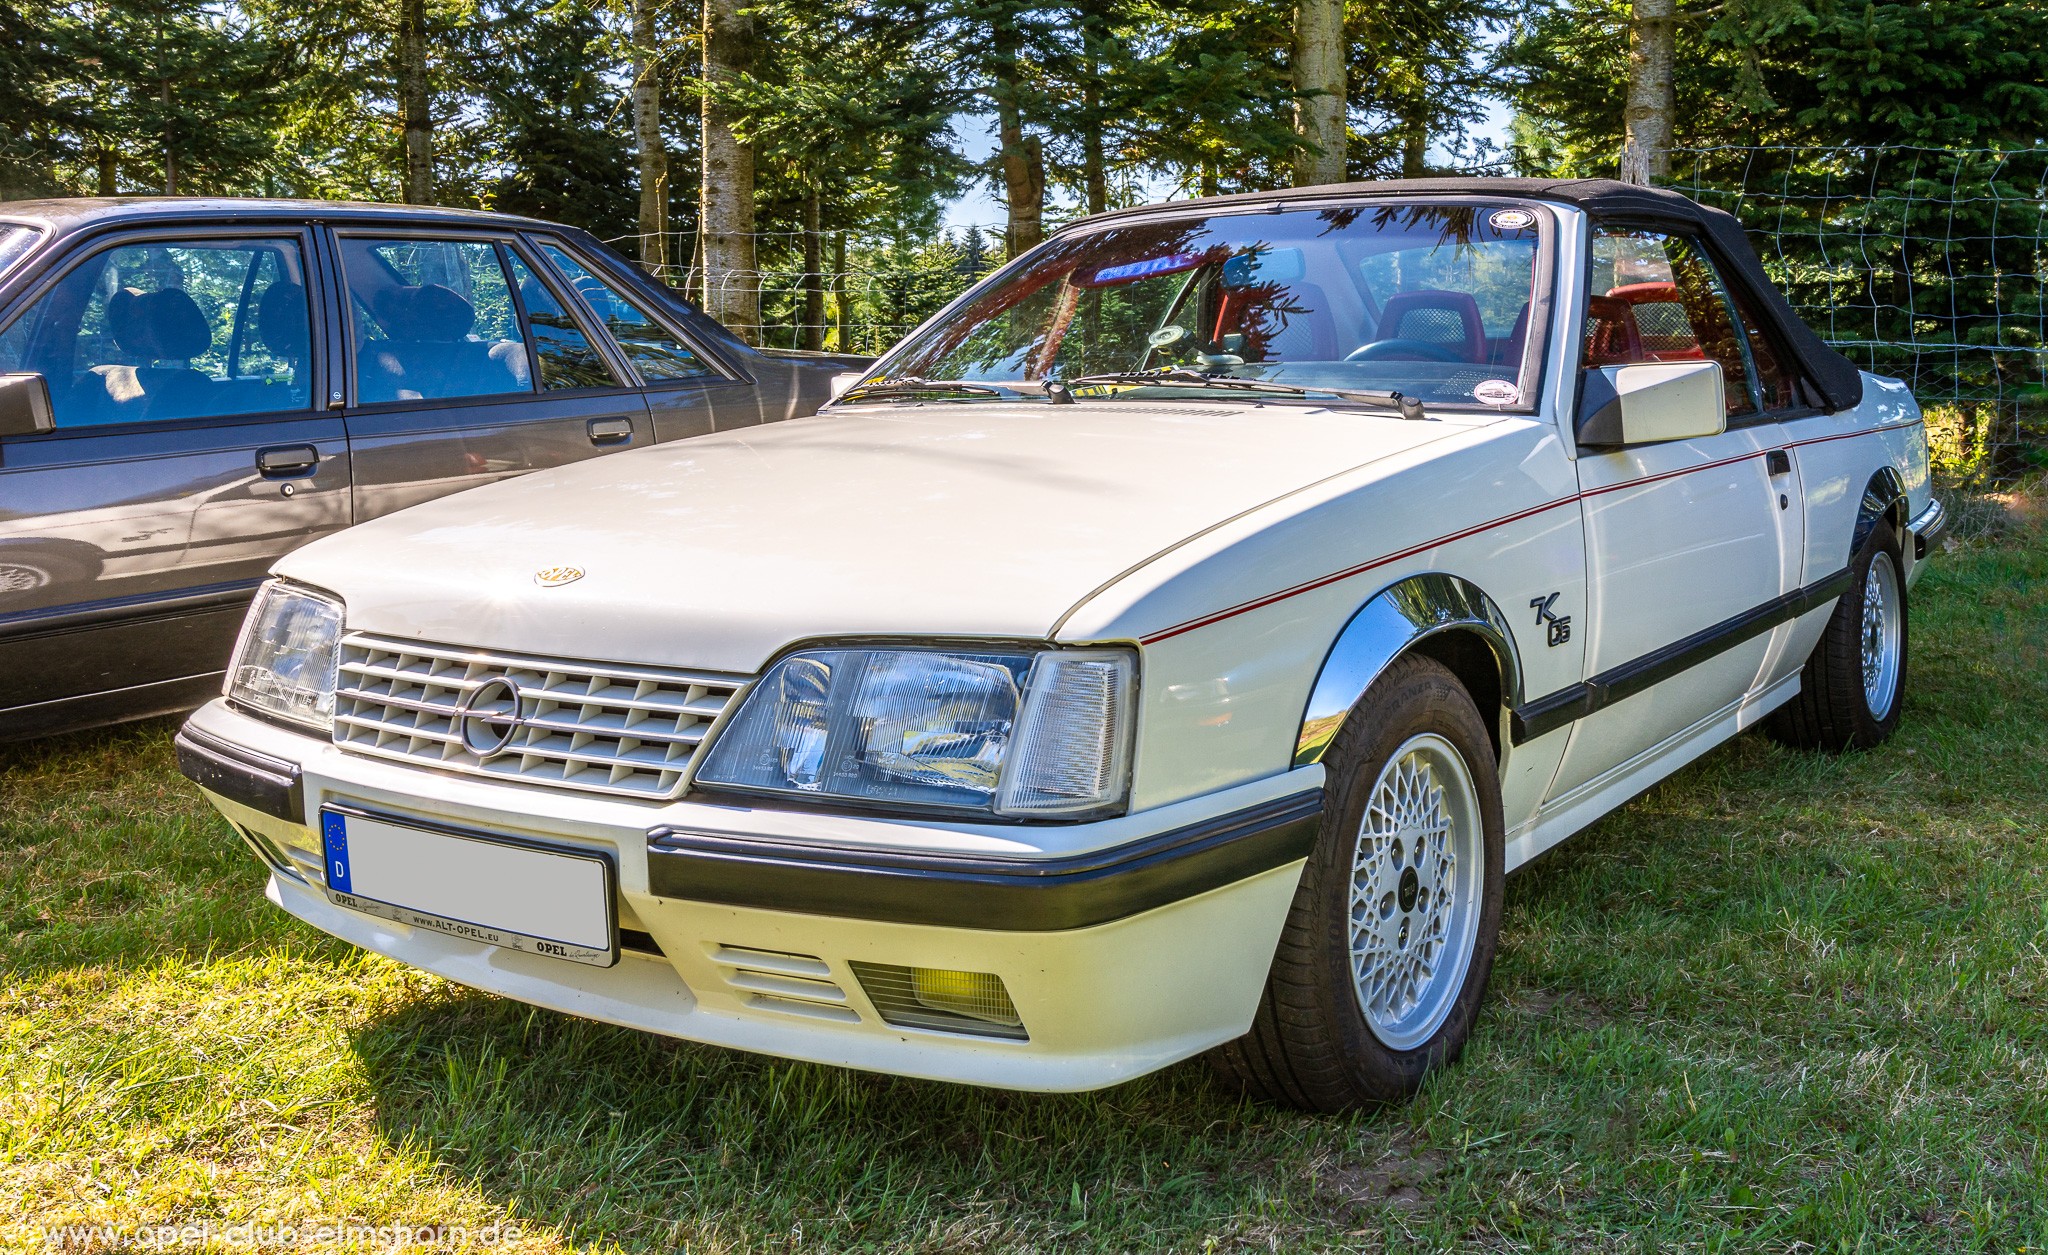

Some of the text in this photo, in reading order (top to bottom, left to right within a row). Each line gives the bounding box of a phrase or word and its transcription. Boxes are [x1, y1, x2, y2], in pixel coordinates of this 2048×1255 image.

[335, 860, 344, 878] D
[335, 893, 358, 908] OPEL
[536, 941, 567, 957] OPEL
